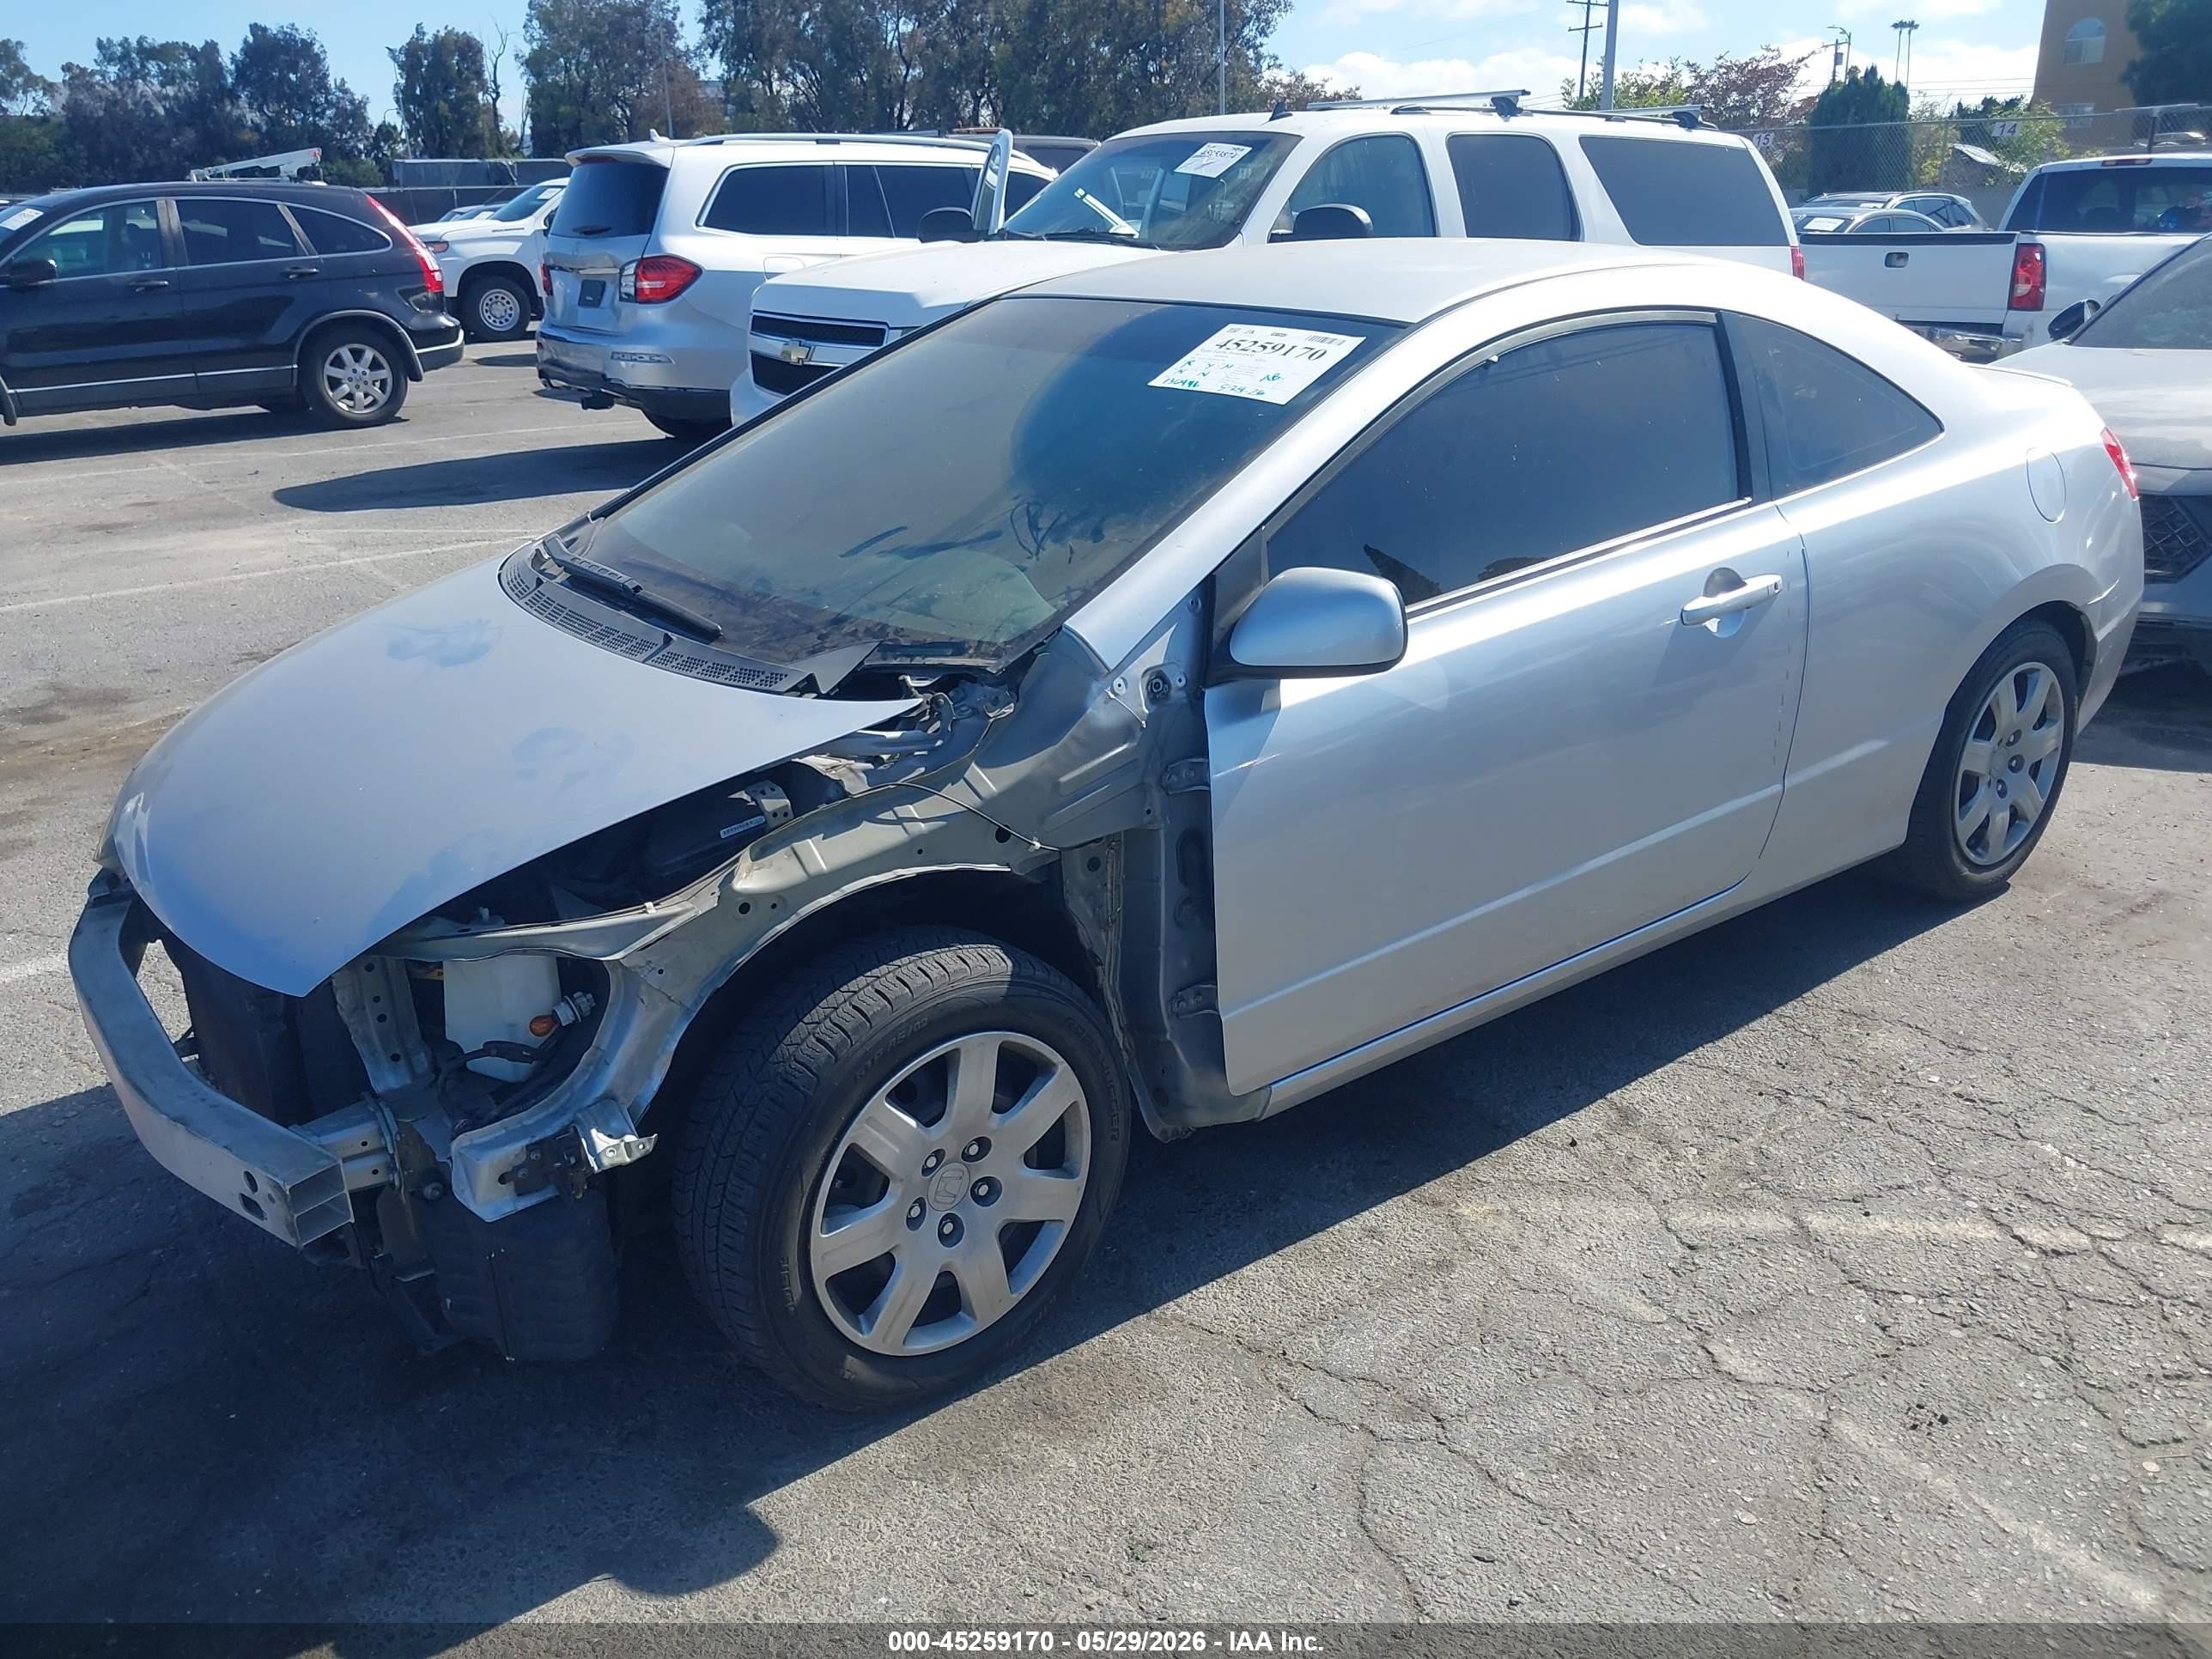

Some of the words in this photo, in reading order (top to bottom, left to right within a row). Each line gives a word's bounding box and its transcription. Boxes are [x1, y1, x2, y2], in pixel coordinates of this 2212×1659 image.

[1999, 123, 2017, 136] 14
[1757, 134, 1771, 146] 15
[1216, 338, 1328, 362] 45259170
